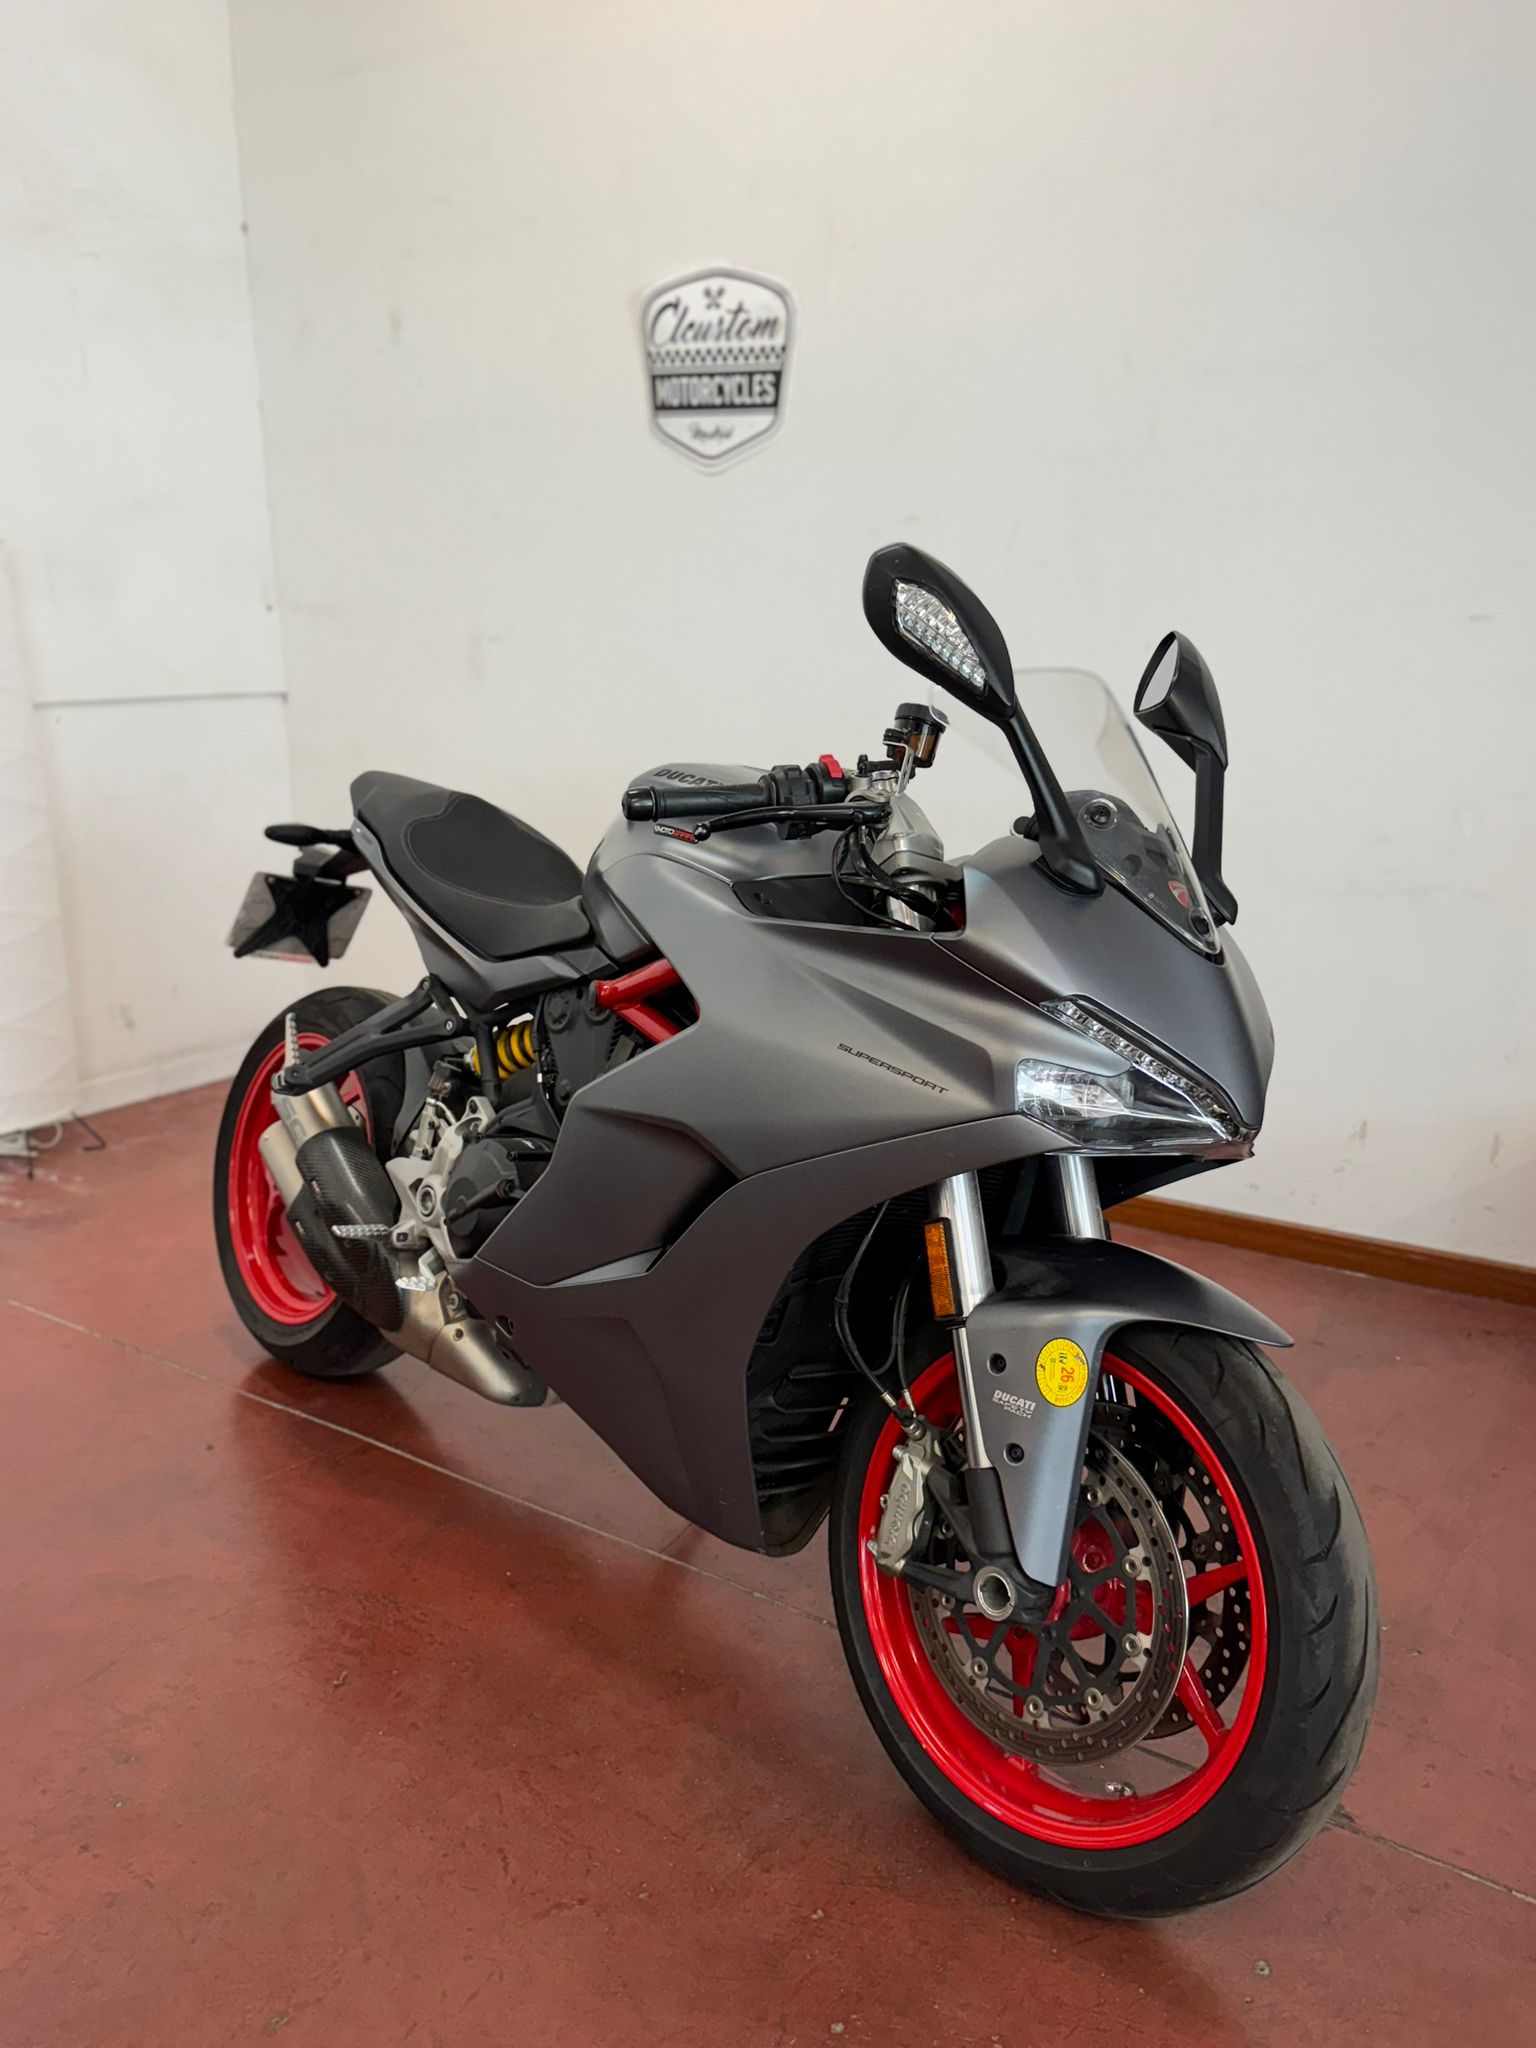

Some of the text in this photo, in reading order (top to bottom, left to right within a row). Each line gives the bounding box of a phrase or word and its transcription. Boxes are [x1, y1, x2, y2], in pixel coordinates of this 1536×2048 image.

[655, 372, 777, 407] MOTORCYCLES
[837, 1042, 949, 1094] SUPERSPORT
[1060, 1366, 1075, 1383] 26
[993, 1389, 1036, 1411] DUCATI
